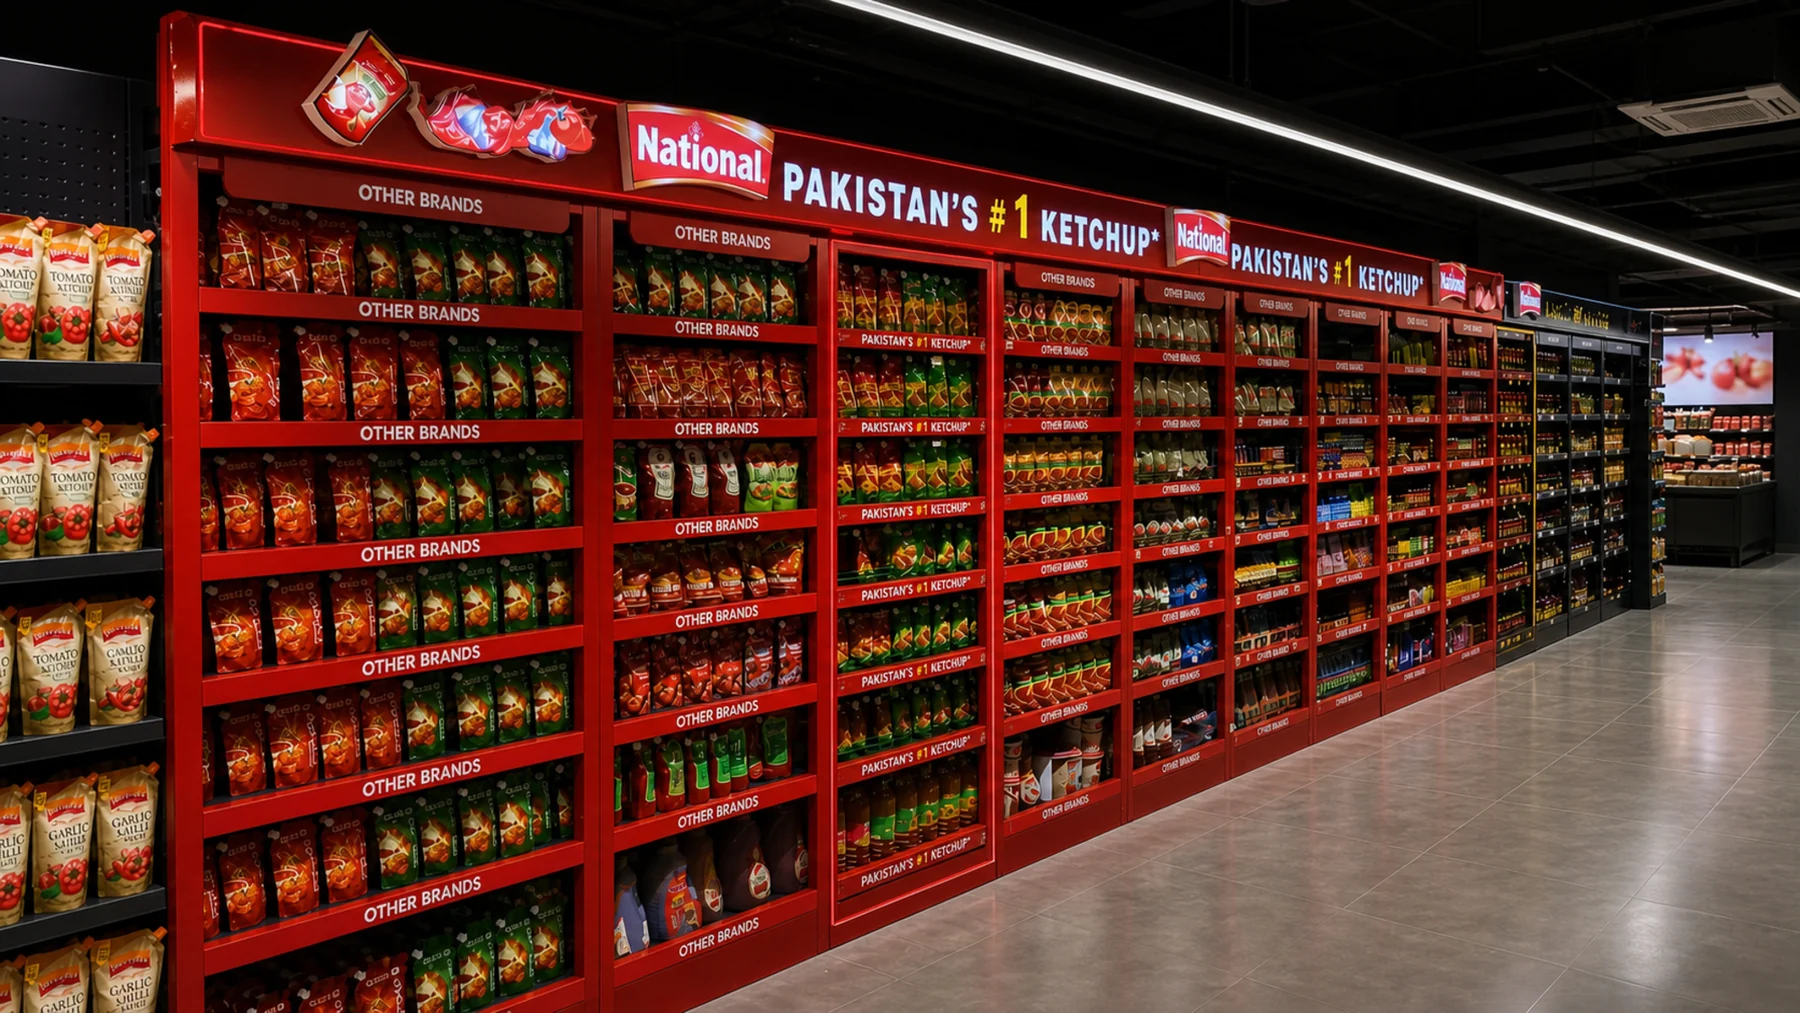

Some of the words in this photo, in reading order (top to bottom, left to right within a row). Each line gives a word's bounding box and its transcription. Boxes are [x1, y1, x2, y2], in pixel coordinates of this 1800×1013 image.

[359, 185, 414, 206] OTHER
[420, 192, 482, 214] BRANDS
[783, 162, 978, 232] PAKISTAN'S
[675, 226, 717, 243] OTHER
[722, 231, 770, 249] BRANDS
[1231, 242, 1329, 284] PAKISTAN'S
[0, 268, 38, 281] OMATO
[50, 271, 94, 283] TOMATO
[359, 302, 413, 319] OTHER
[419, 305, 479, 322] BRANDS
[675, 321, 712, 335] OTHER
[716, 324, 758, 337] BRANDS
[862, 334, 913, 347] PAKISTAN'S
[360, 426, 414, 440] OTHER
[420, 425, 479, 439] BRANDS
[675, 423, 712, 435] OTHER
[716, 422, 758, 434] BRANDS
[862, 422, 913, 432] PAKISTAN'S
[51, 472, 96, 483] TOMATO
[862, 506, 913, 519] PAKISTAN'S
[676, 521, 712, 535] OTHER
[716, 517, 758, 531] BRANDS
[361, 544, 415, 562] OTHER
[420, 539, 480, 557] BRANDS
[862, 584, 913, 601] PAKISTAN'S
[676, 612, 713, 627] OTHER
[716, 605, 758, 622] BRANDS
[33, 649, 79, 665] TOMATO
[362, 655, 415, 675] OTHER
[421, 645, 480, 667] BRANDS
[862, 667, 913, 687] PAKISTAN'S
[677, 709, 713, 727] OTHER
[716, 700, 758, 719] BRANDS
[862, 752, 913, 775] PAKISTAN'S
[363, 773, 415, 796] OTHER
[421, 759, 480, 784] BRANDS
[678, 808, 713, 828] OTHER
[717, 796, 758, 817] BRANDS
[48, 822, 89, 842] GARLIC
[862, 858, 913, 887] PAKISTAN'S
[364, 896, 416, 922] OTHER
[422, 876, 481, 906] BRANDS
[679, 934, 714, 956] OTHER
[718, 917, 759, 942] BRANDS
[110, 976, 152, 996] GARLIC
